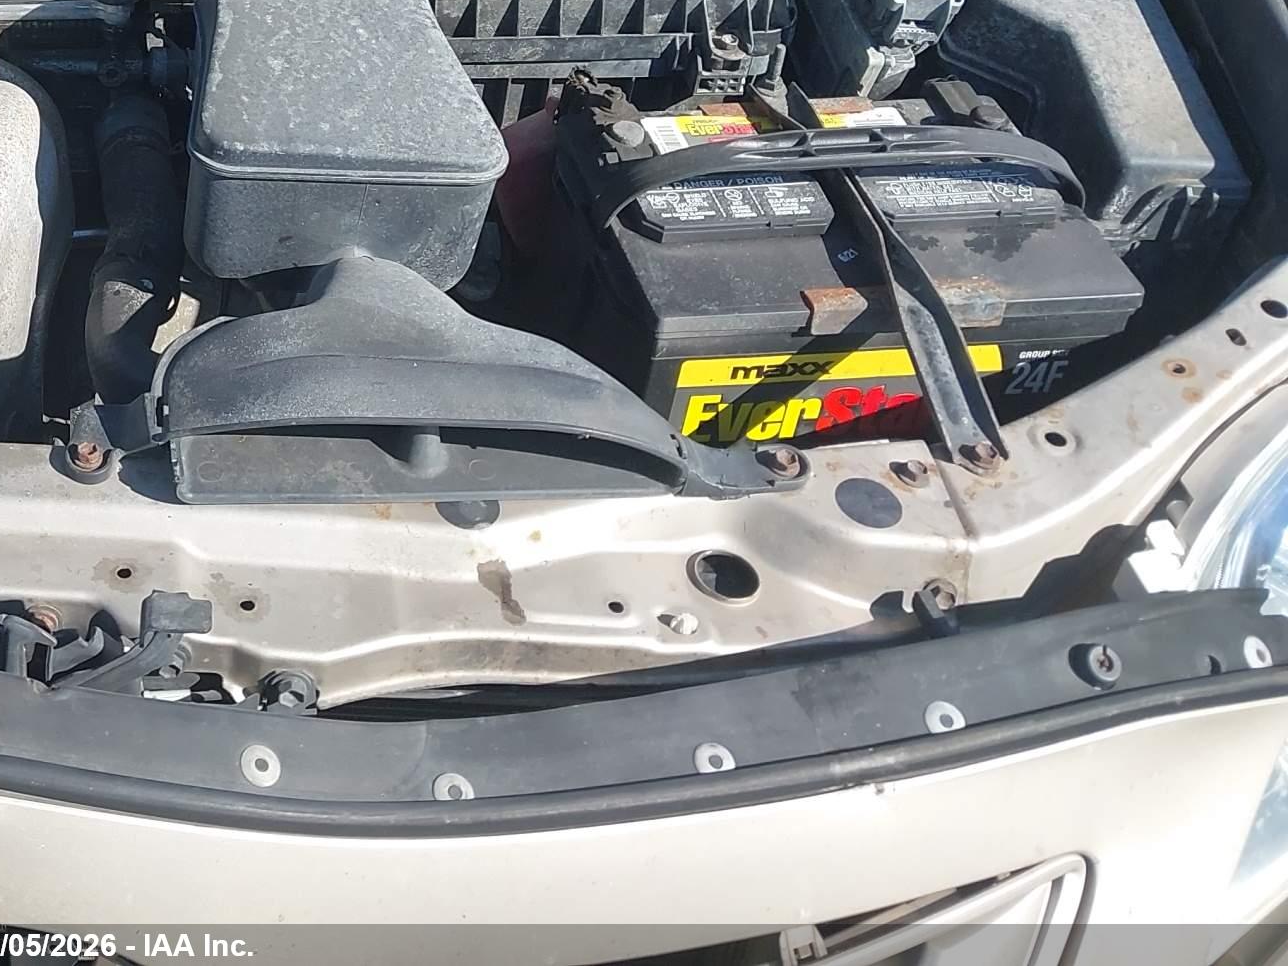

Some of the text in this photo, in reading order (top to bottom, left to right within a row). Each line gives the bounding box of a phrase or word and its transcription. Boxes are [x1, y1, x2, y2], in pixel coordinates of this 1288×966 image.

[673, 179, 724, 190] DANGER
[736, 175, 784, 185] POISON
[1018, 349, 1051, 360] GROUP
[730, 360, 833, 380] maxx
[1004, 360, 1069, 395] 24F
